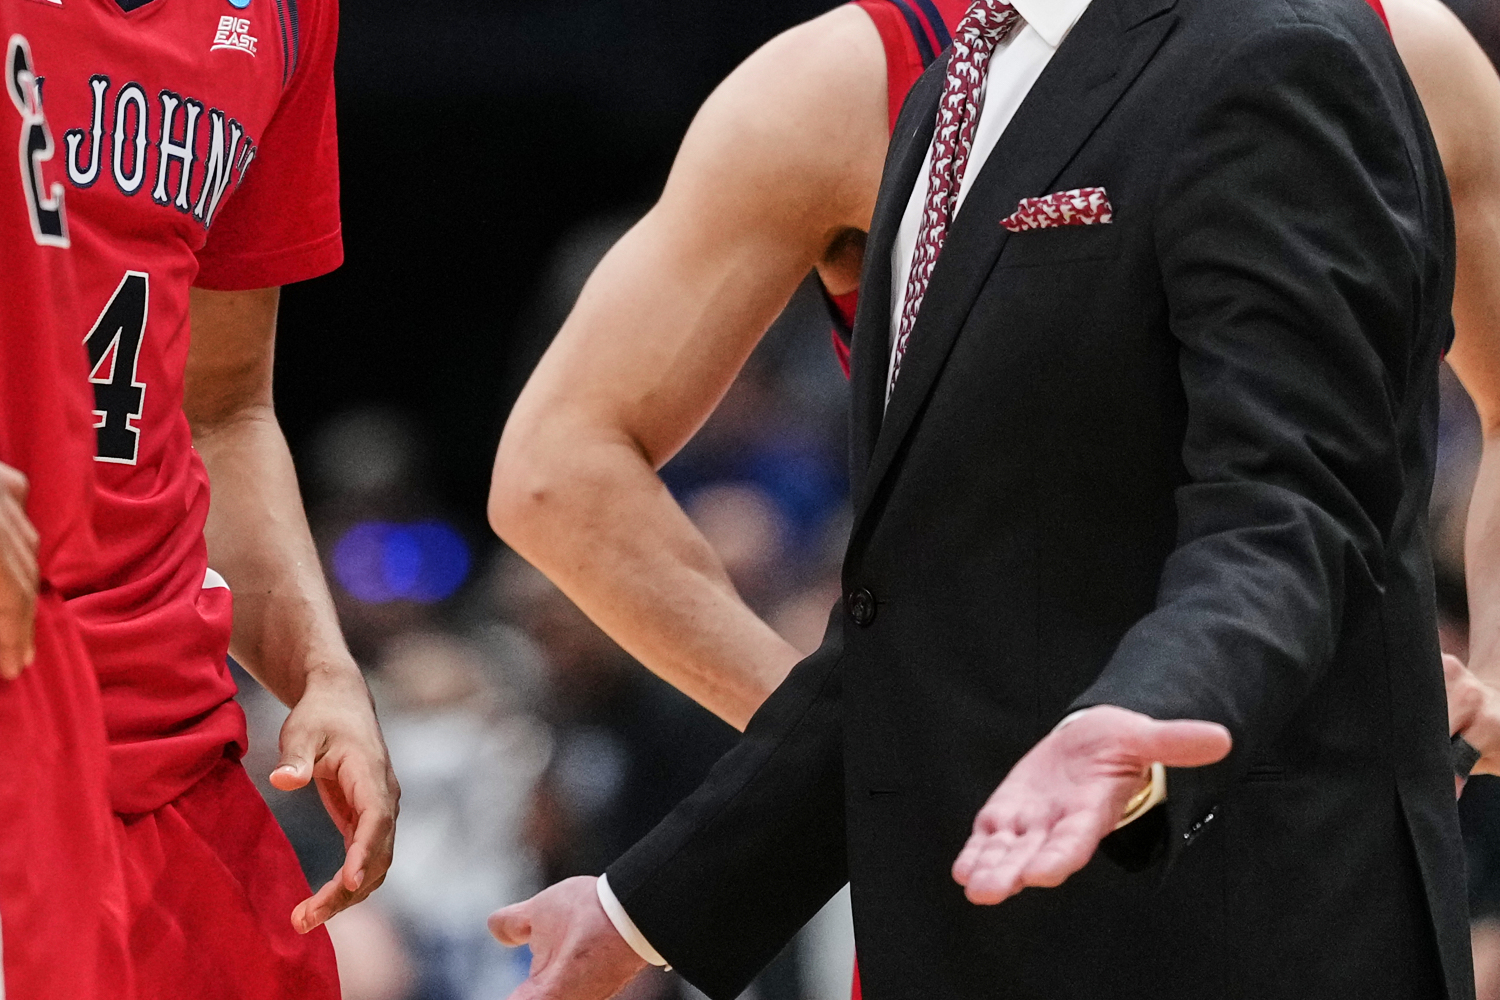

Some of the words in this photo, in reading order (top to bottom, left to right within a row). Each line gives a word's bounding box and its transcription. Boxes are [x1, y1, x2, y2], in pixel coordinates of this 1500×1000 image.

[218, 15, 251, 34] BIG
[213, 30, 258, 51] EAST
[81, 269, 149, 466] 4
